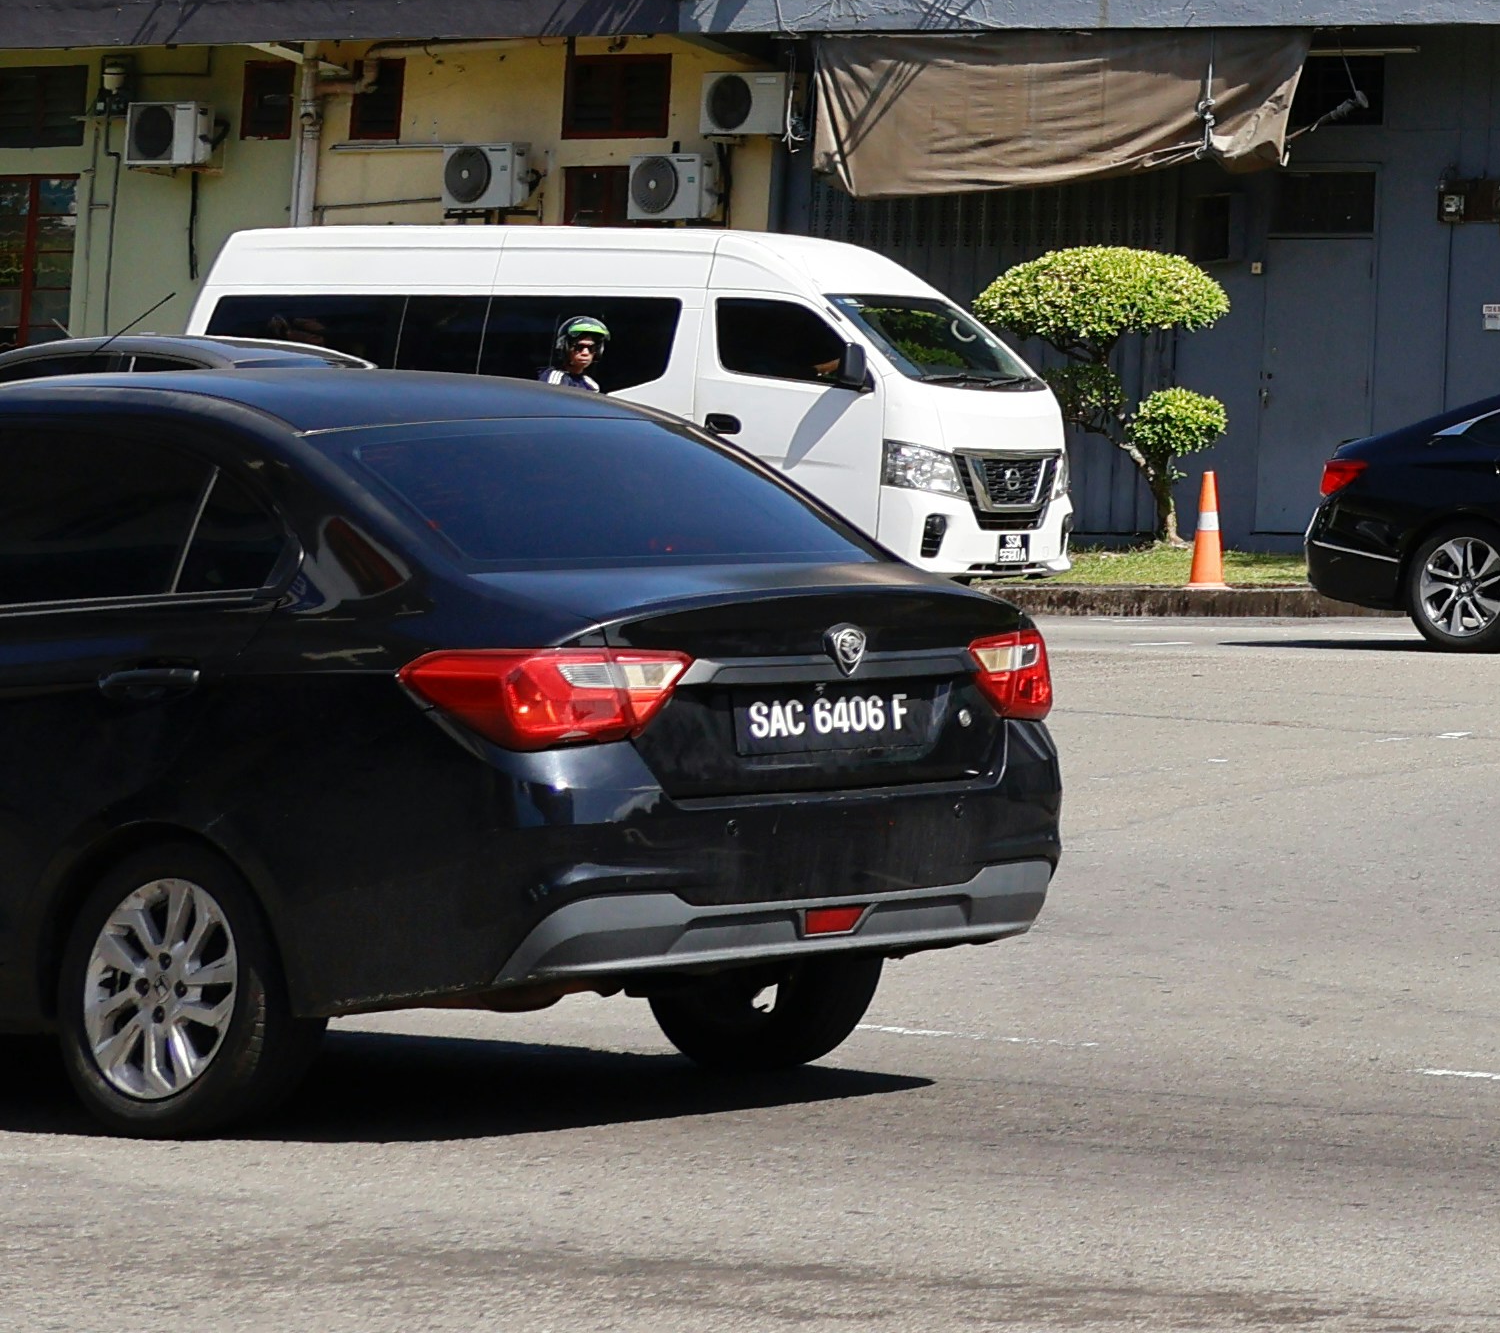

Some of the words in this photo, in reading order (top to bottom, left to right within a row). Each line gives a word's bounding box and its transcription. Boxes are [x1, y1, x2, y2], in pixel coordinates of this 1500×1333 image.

[750, 699, 805, 738] SAC
[813, 695, 885, 734] 6406
[892, 694, 907, 730] F
